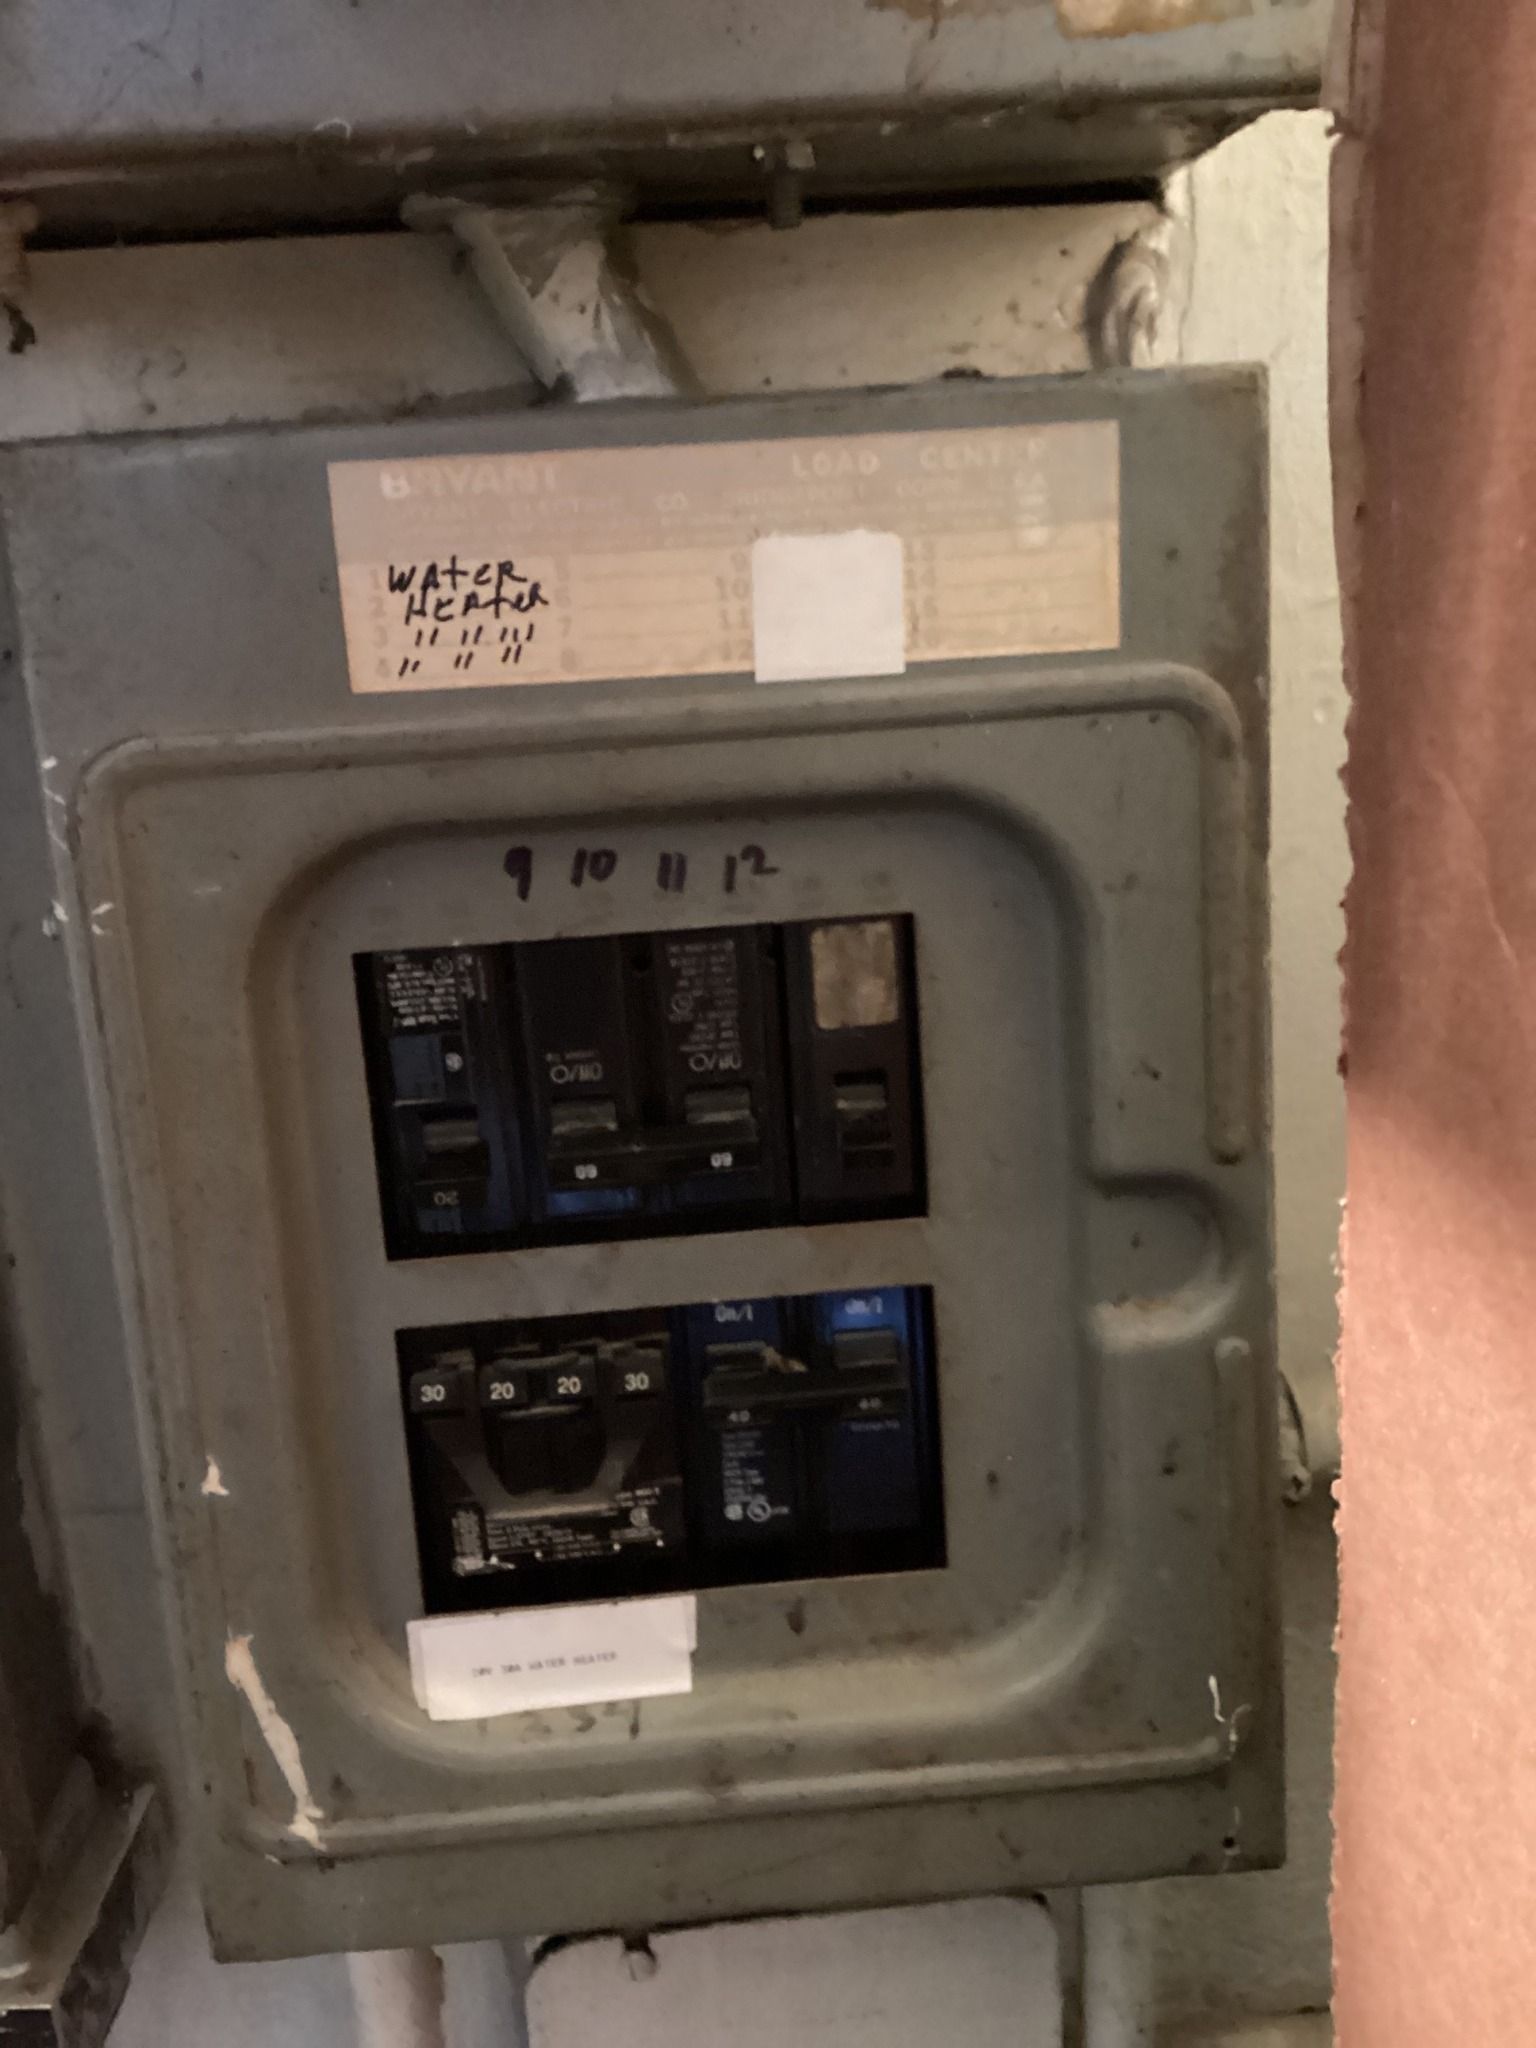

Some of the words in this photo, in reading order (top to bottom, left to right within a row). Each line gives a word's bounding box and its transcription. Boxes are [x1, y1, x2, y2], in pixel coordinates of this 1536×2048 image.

[920, 437, 1046, 470] CENTR
[504, 846, 533, 901] 9
[570, 847, 618, 888] 10
[656, 852, 688, 893] 11
[723, 844, 780, 894] 12
[420, 1384, 446, 1403] 30
[489, 1381, 515, 1400] 20
[556, 1376, 582, 1395] 20
[624, 1371, 650, 1392] 30
